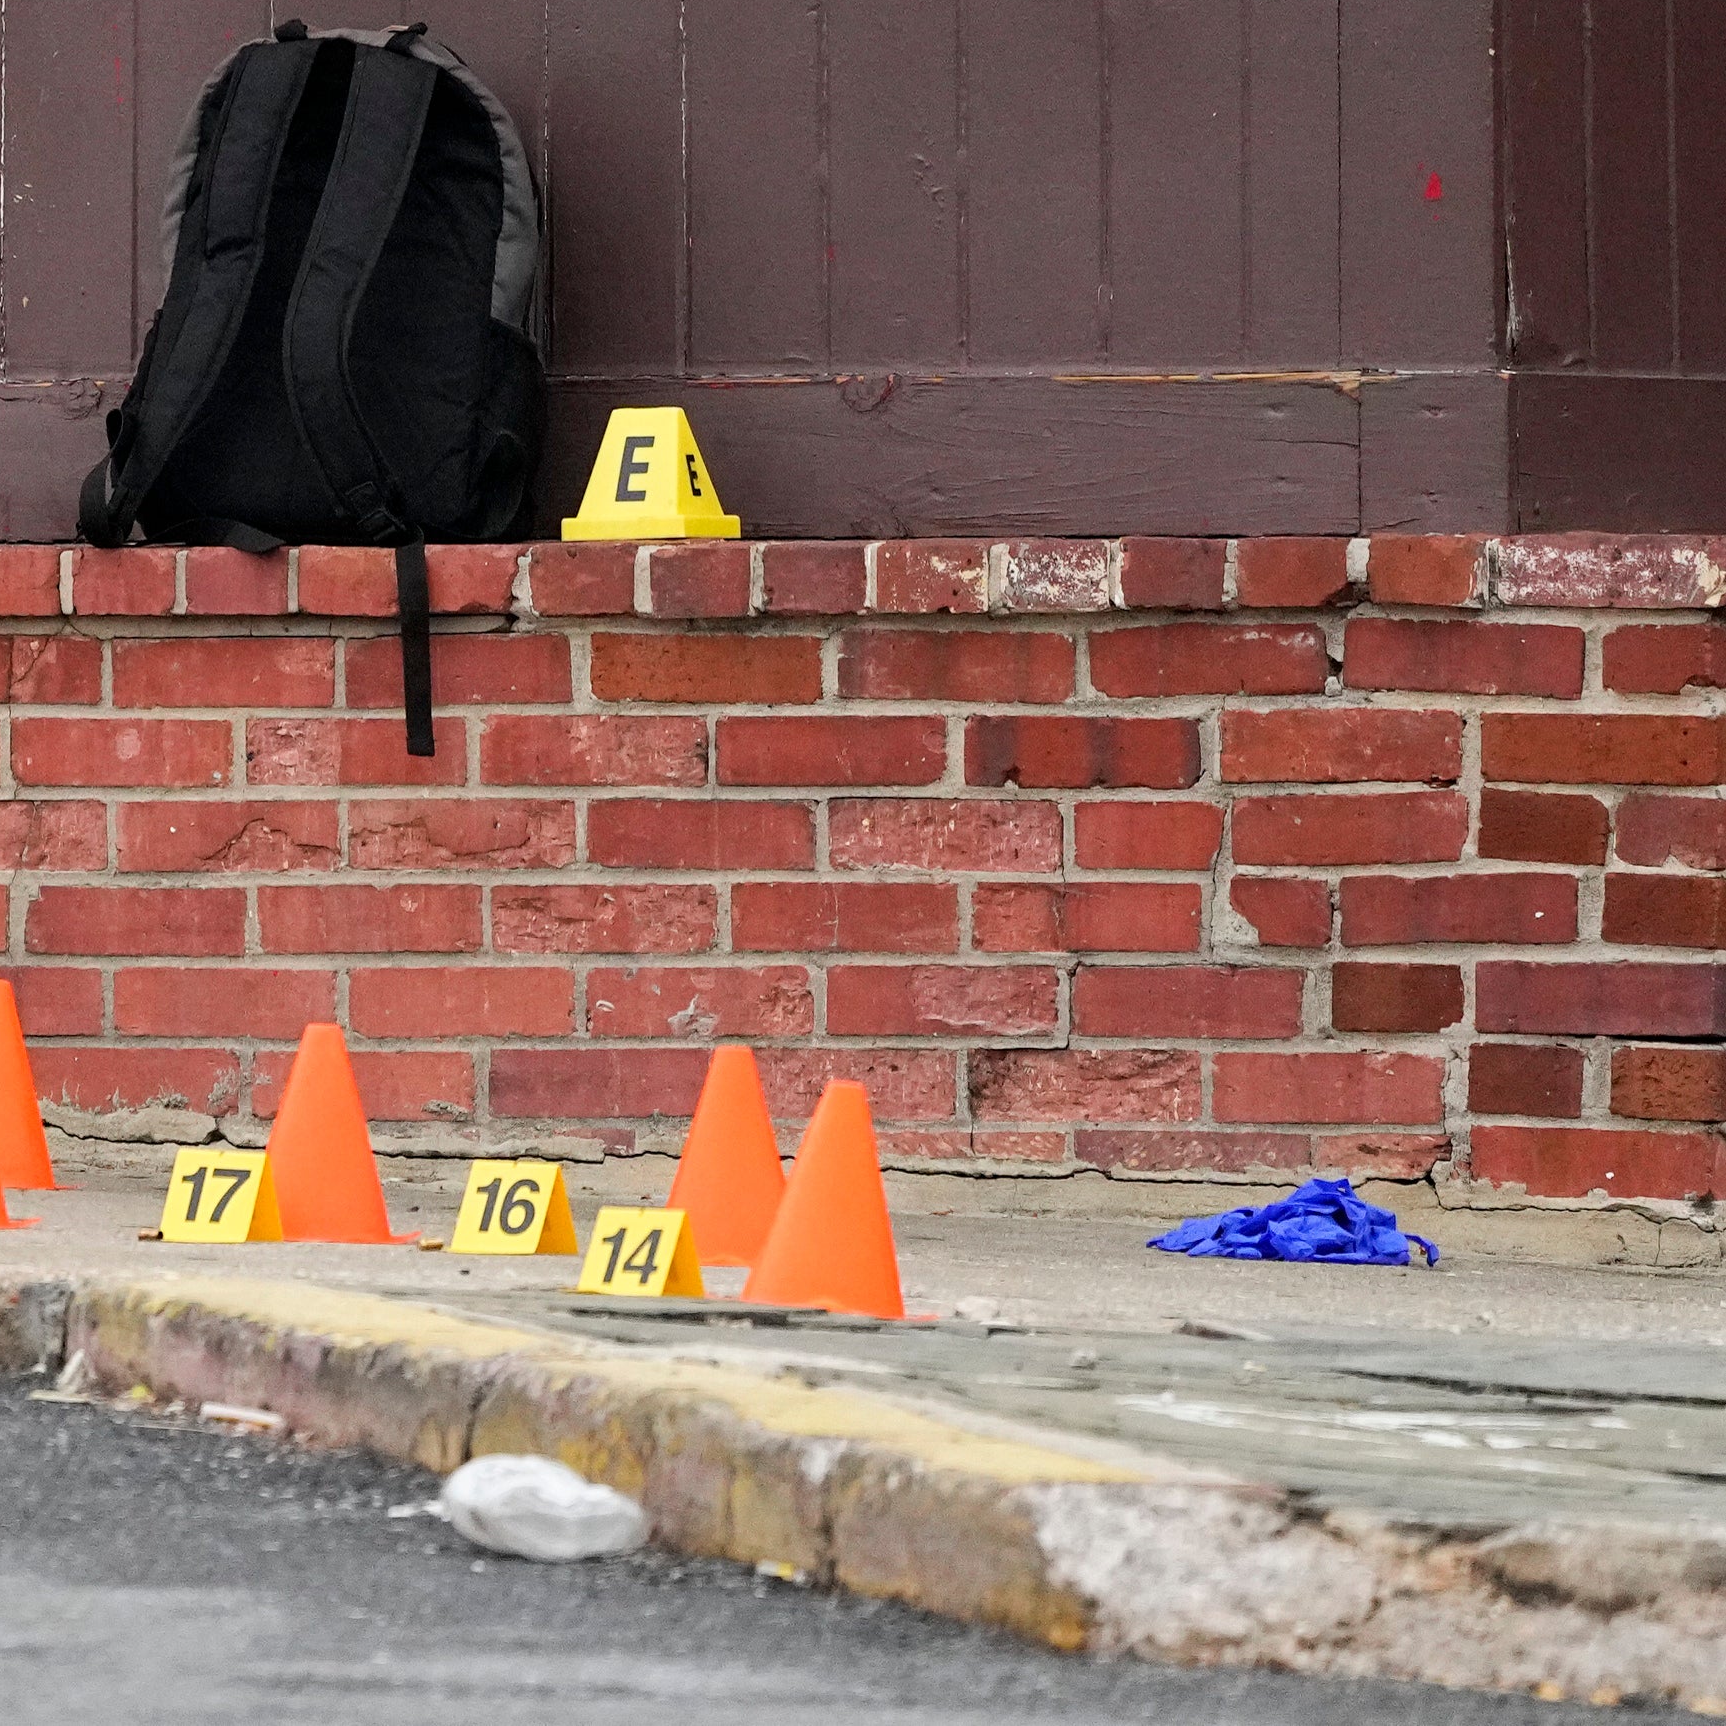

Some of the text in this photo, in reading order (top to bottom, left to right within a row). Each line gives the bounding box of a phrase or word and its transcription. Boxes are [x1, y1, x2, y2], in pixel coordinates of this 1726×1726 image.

[615, 436, 655, 502] E
[686, 454, 702, 496] E
[181, 1166, 251, 1224] 17
[476, 1176, 541, 1235] 16
[601, 1227, 663, 1284] 14
